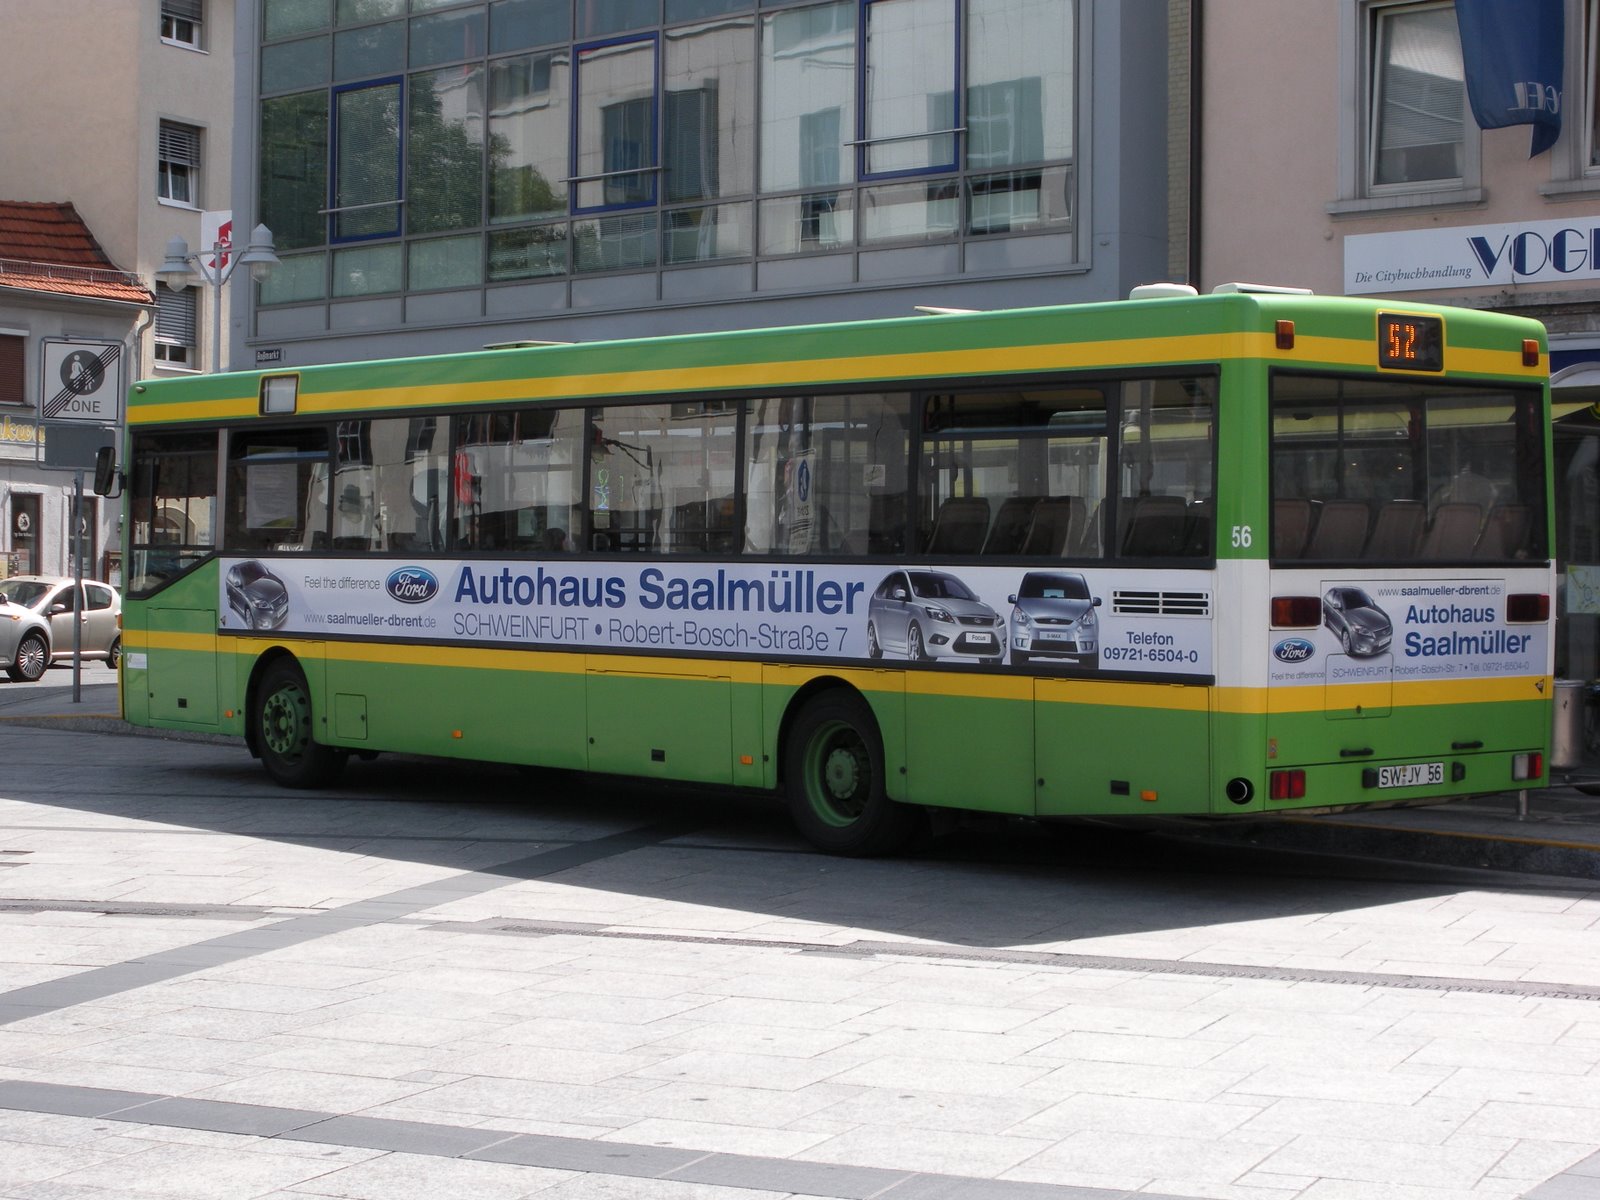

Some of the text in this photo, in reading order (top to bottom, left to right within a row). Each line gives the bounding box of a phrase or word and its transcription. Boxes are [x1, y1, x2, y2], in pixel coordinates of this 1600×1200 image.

[1355, 266, 1472, 284] Die Citybuchhandlung
[1389, 323, 1415, 358] 52
[63, 400, 101, 413] ZONE
[1231, 525, 1252, 548] 56
[304, 575, 380, 590] Feel the difference
[394, 572, 428, 597] Ford
[454, 566, 865, 615] Autohaus Saalmüller
[1377, 585, 1501, 597] www.saalmueller-dbrent.de
[304, 612, 437, 628] www.saalmueller-dbrent.de
[1405, 604, 1495, 624] Autohaus
[454, 612, 848, 651] SCHWEINFURT Robert-Bosch-Straße 7
[971, 634, 987, 642] Focus
[1125, 631, 1174, 646] Telefon
[1280, 642, 1308, 659] Ford
[1404, 630, 1531, 657] Saalmüller
[1103, 647, 1198, 663] 09721-6504-0
[1271, 669, 1326, 680] Feel the difference
[1332, 667, 1389, 679] SCHWEINFURT
[1458, 663, 1463, 671] 7
[1428, 765, 1442, 781] 56
